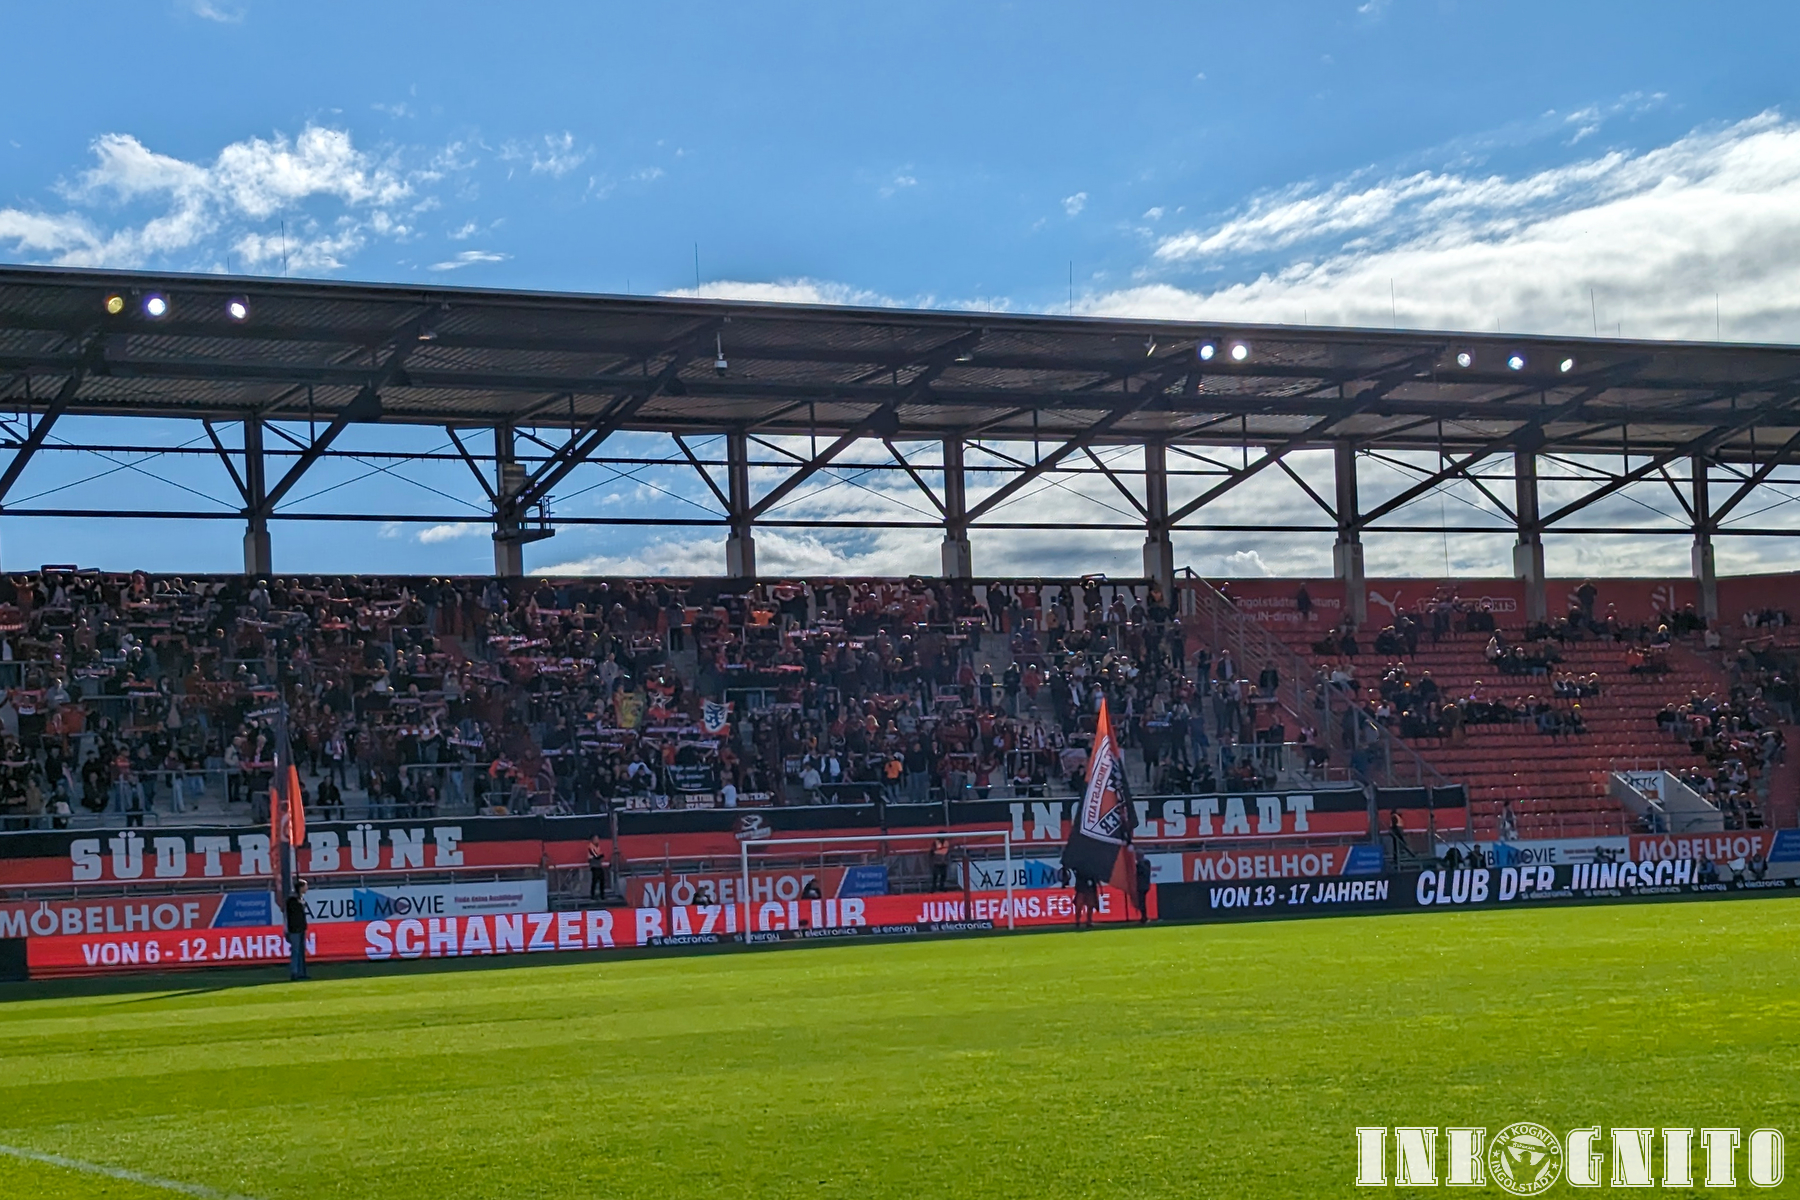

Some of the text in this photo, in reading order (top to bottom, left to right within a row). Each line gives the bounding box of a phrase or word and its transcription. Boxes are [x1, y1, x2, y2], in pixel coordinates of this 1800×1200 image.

[1009, 795, 1314, 840] INLSTADT
[1507, 848, 1557, 864] MOVIE
[1639, 835, 1763, 861] MÖBELHOF
[1193, 852, 1334, 880] MÖBELHOF
[1210, 887, 1251, 909] VON
[1254, 885, 1276, 906] 13
[1288, 884, 1310, 905] 17
[1312, 880, 1389, 903] JAHREN
[1416, 868, 1490, 906] CLUB
[1499, 866, 1556, 900] DER
[1699, 882, 1727, 892] energy
[1744, 879, 1786, 889] electronics
[374, 895, 444, 917] MOVIE
[1, 901, 200, 937] MÖBELHOF
[365, 898, 866, 960] SCHANZER BAZI CLUB
[883, 924, 917, 934] energy
[940, 920, 993, 932] electronics
[663, 934, 719, 945] electronics
[746, 931, 780, 943] nergy
[805, 926, 858, 938] electronics
[82, 942, 139, 966] VON
[145, 941, 160, 963] 6
[179, 938, 208, 962] 12
